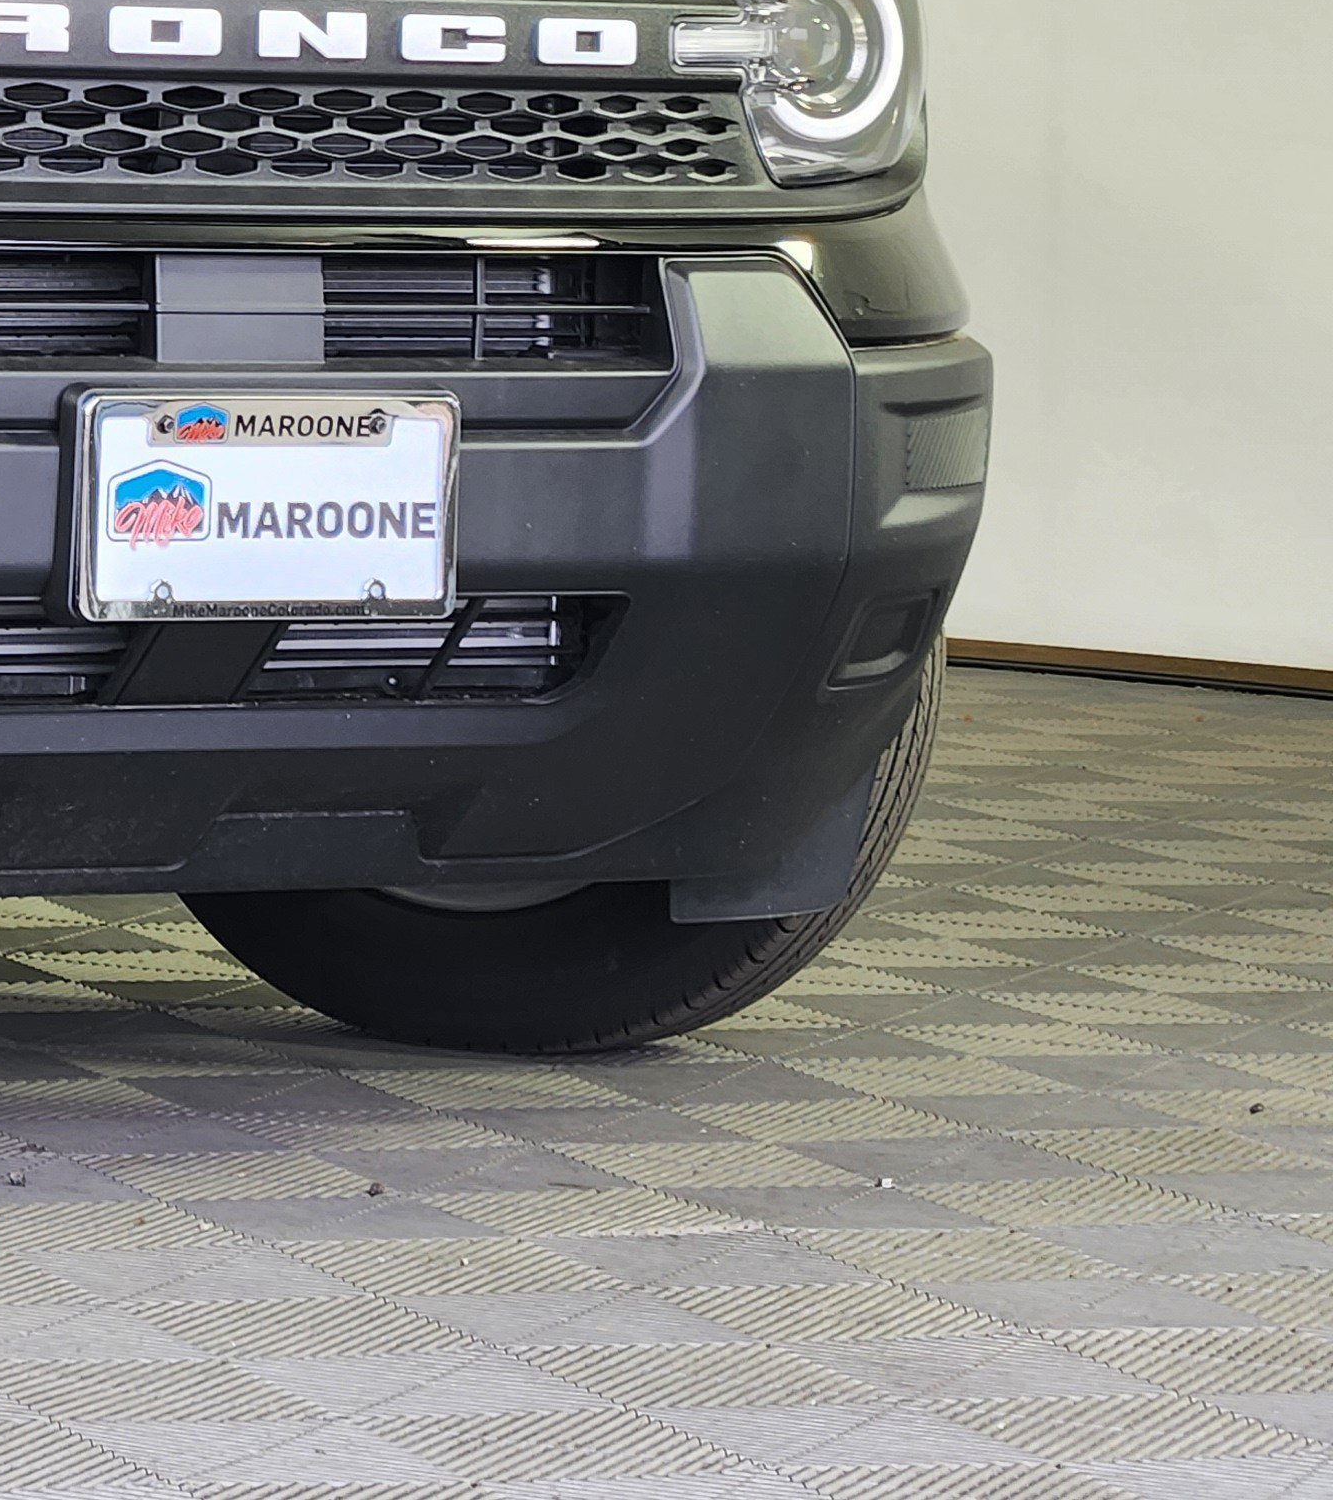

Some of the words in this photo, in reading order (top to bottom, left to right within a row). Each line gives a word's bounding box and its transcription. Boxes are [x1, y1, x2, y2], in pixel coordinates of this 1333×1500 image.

[235, 414, 372, 438] MAROONE
[114, 496, 204, 550] Mike
[217, 501, 436, 539] MAROONE
